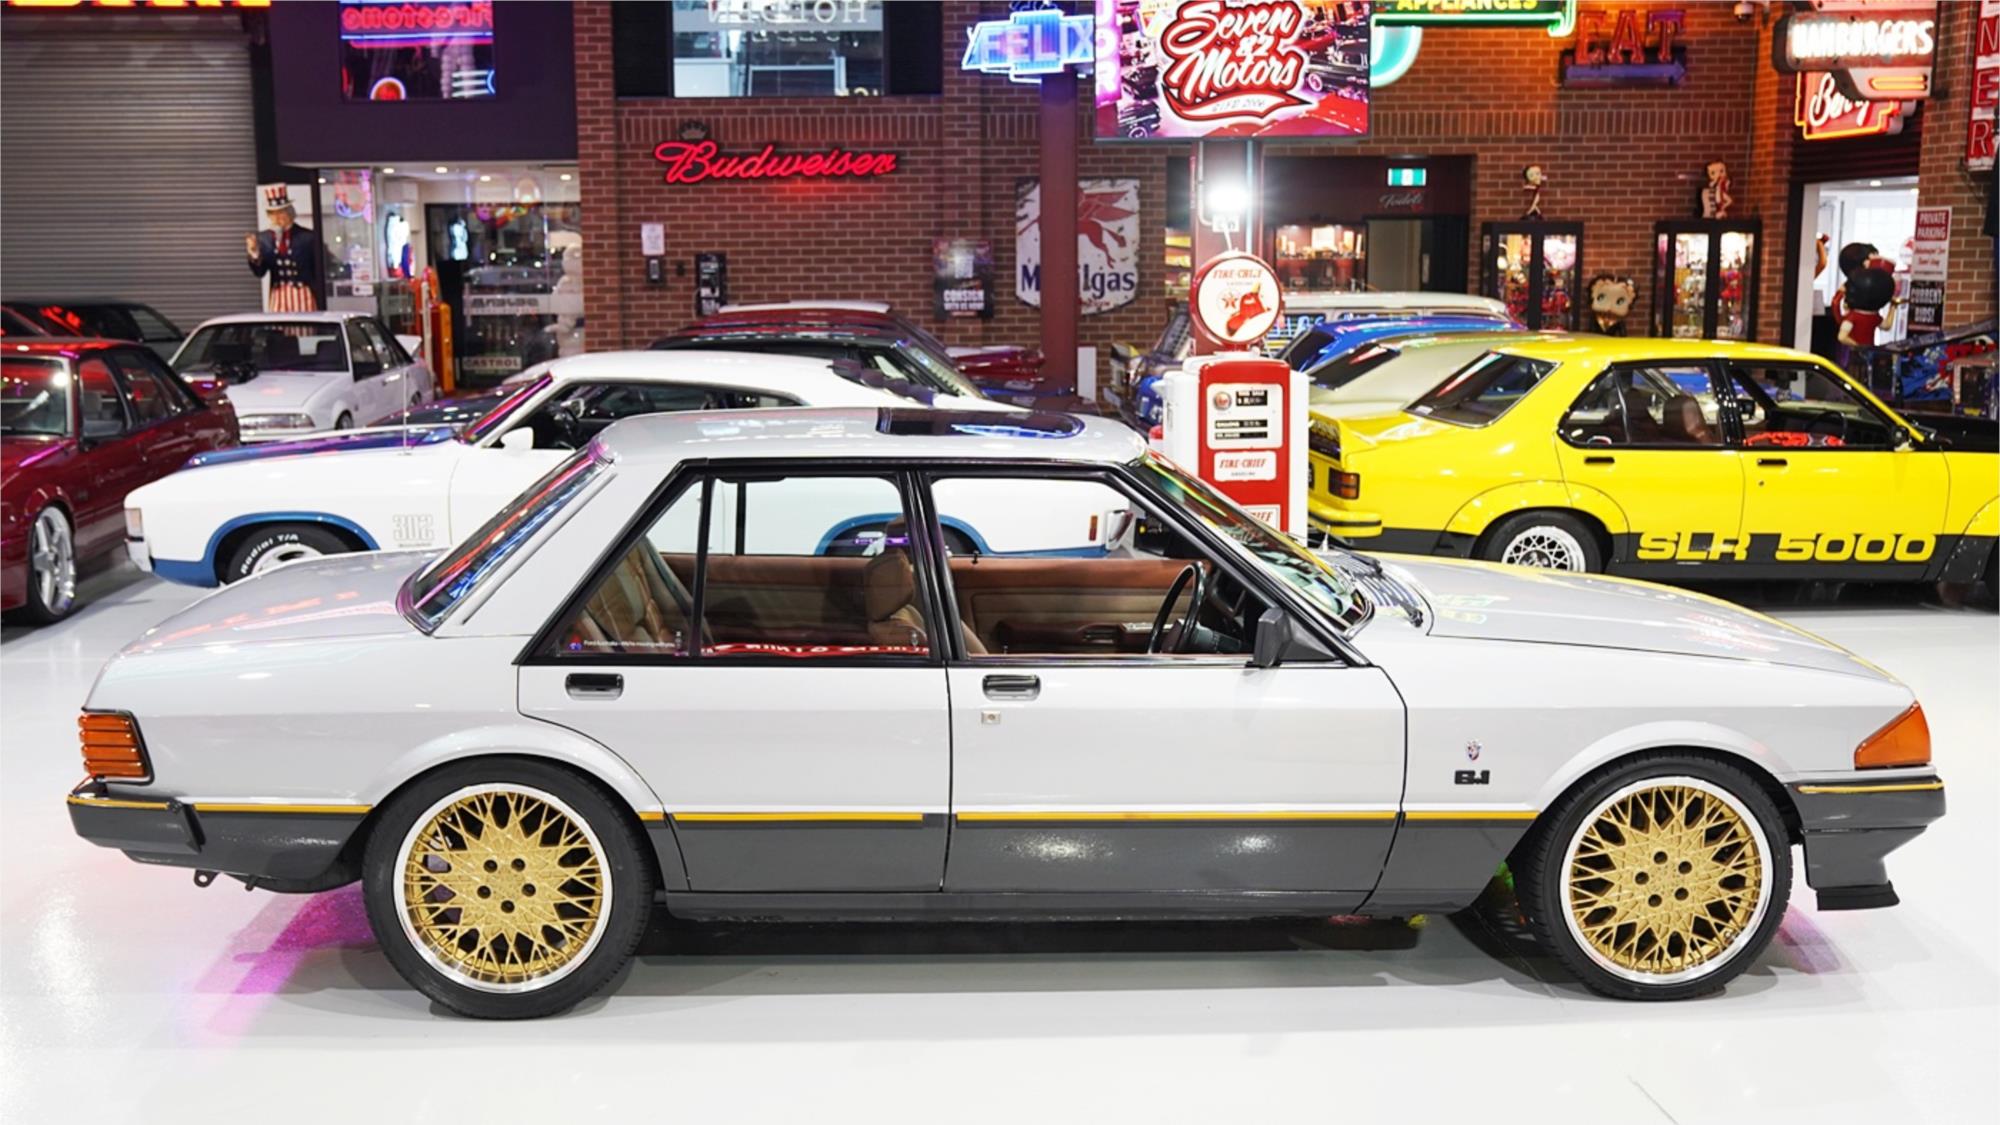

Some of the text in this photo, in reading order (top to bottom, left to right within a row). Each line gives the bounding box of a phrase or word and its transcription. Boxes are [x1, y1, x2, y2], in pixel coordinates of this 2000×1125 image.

[979, 21, 1095, 64] FELIX
[1166, 2, 1297, 55] Seven
[1575, 9, 1686, 65] EAT
[1792, 20, 1935, 58] HAMBURGERS
[1168, 47, 1298, 101] Motors
[654, 140, 897, 184] Budweiser
[240, 533, 299, 575] Radial T/A
[1637, 531, 1937, 562] SLR 5000
